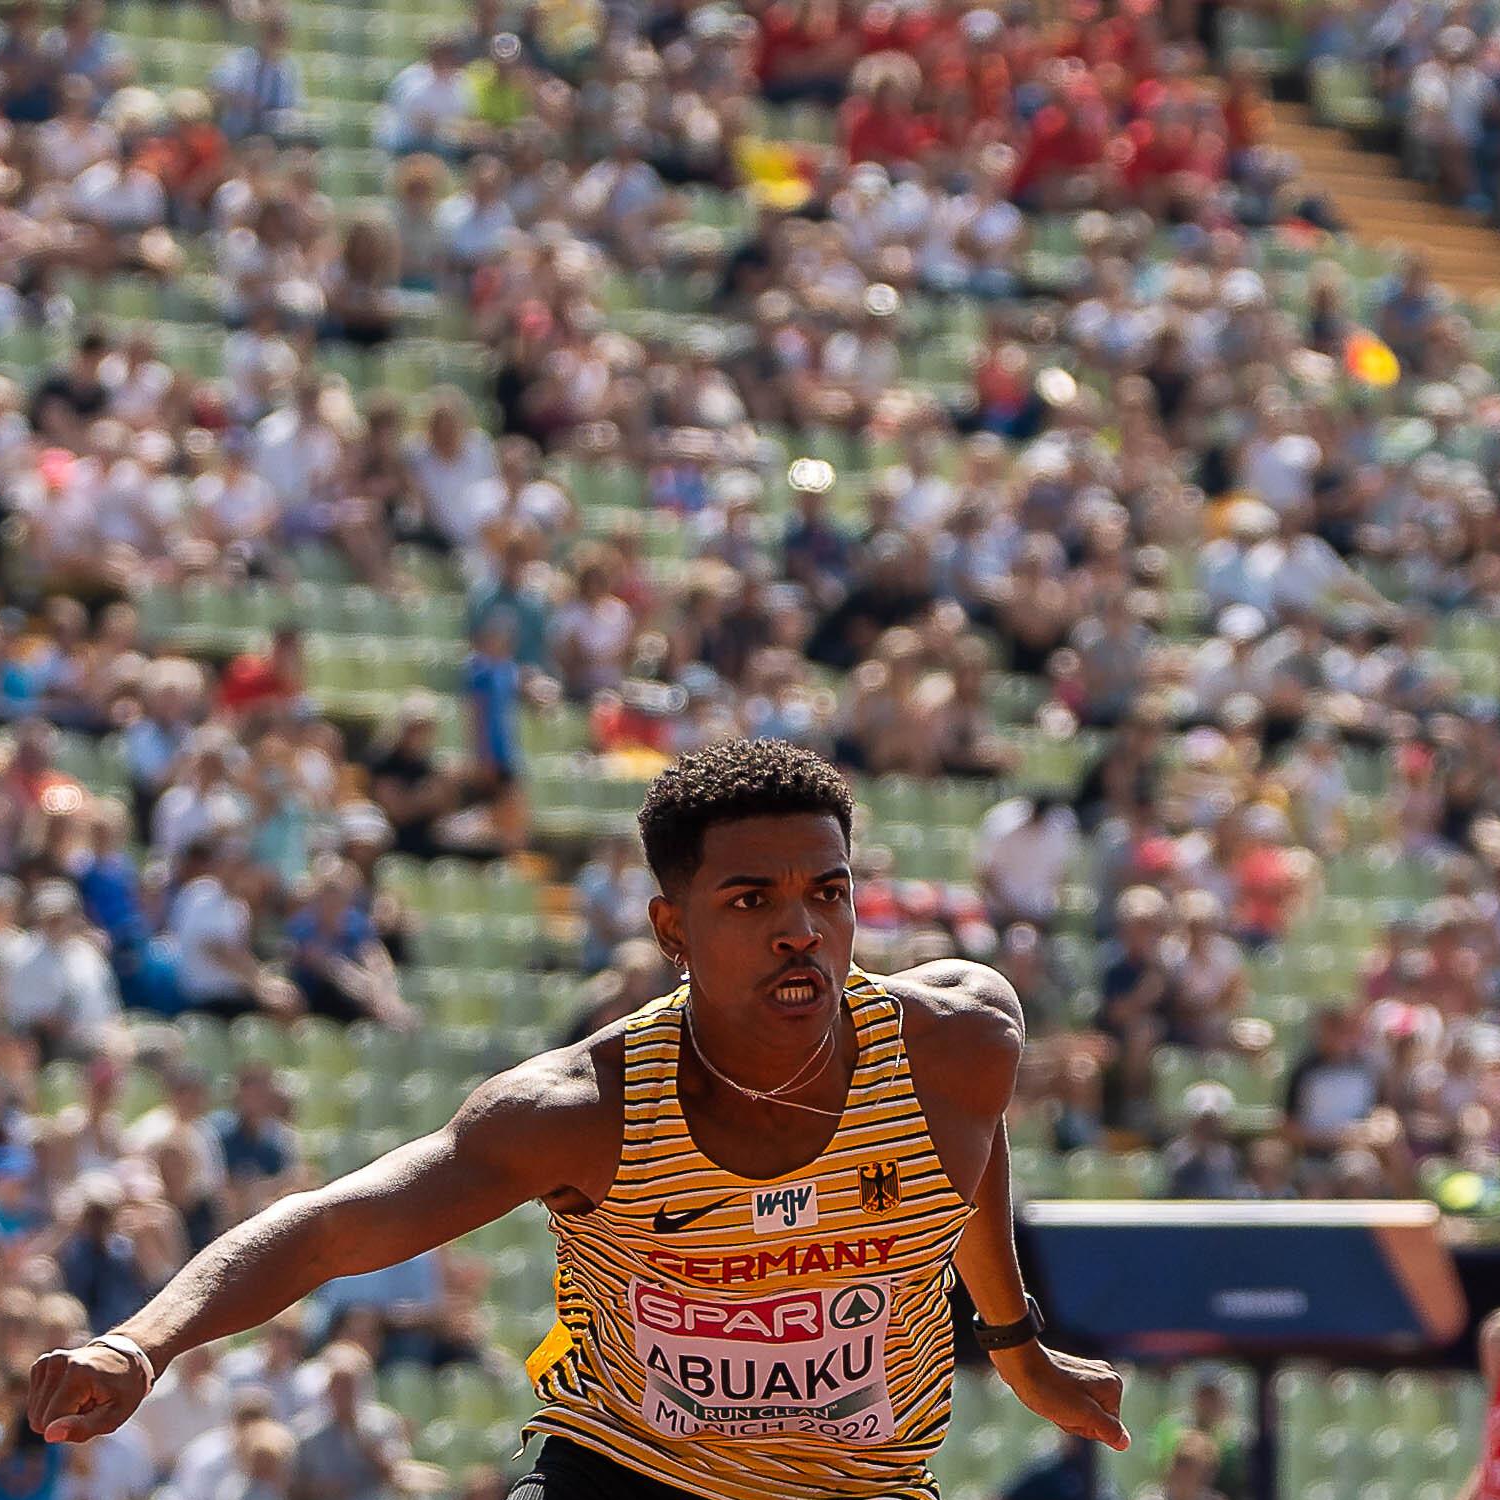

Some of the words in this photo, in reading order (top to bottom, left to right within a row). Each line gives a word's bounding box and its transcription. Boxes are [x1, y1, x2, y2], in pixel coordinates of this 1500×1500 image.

[648, 1235, 900, 1285] GERMANY
[640, 1295, 817, 1339] SPAR
[646, 1334, 875, 1400] ABUAKU
[655, 1399, 785, 1437] MUNICH
[797, 1413, 882, 1441] 2022
[703, 1407, 751, 1421] RUN
